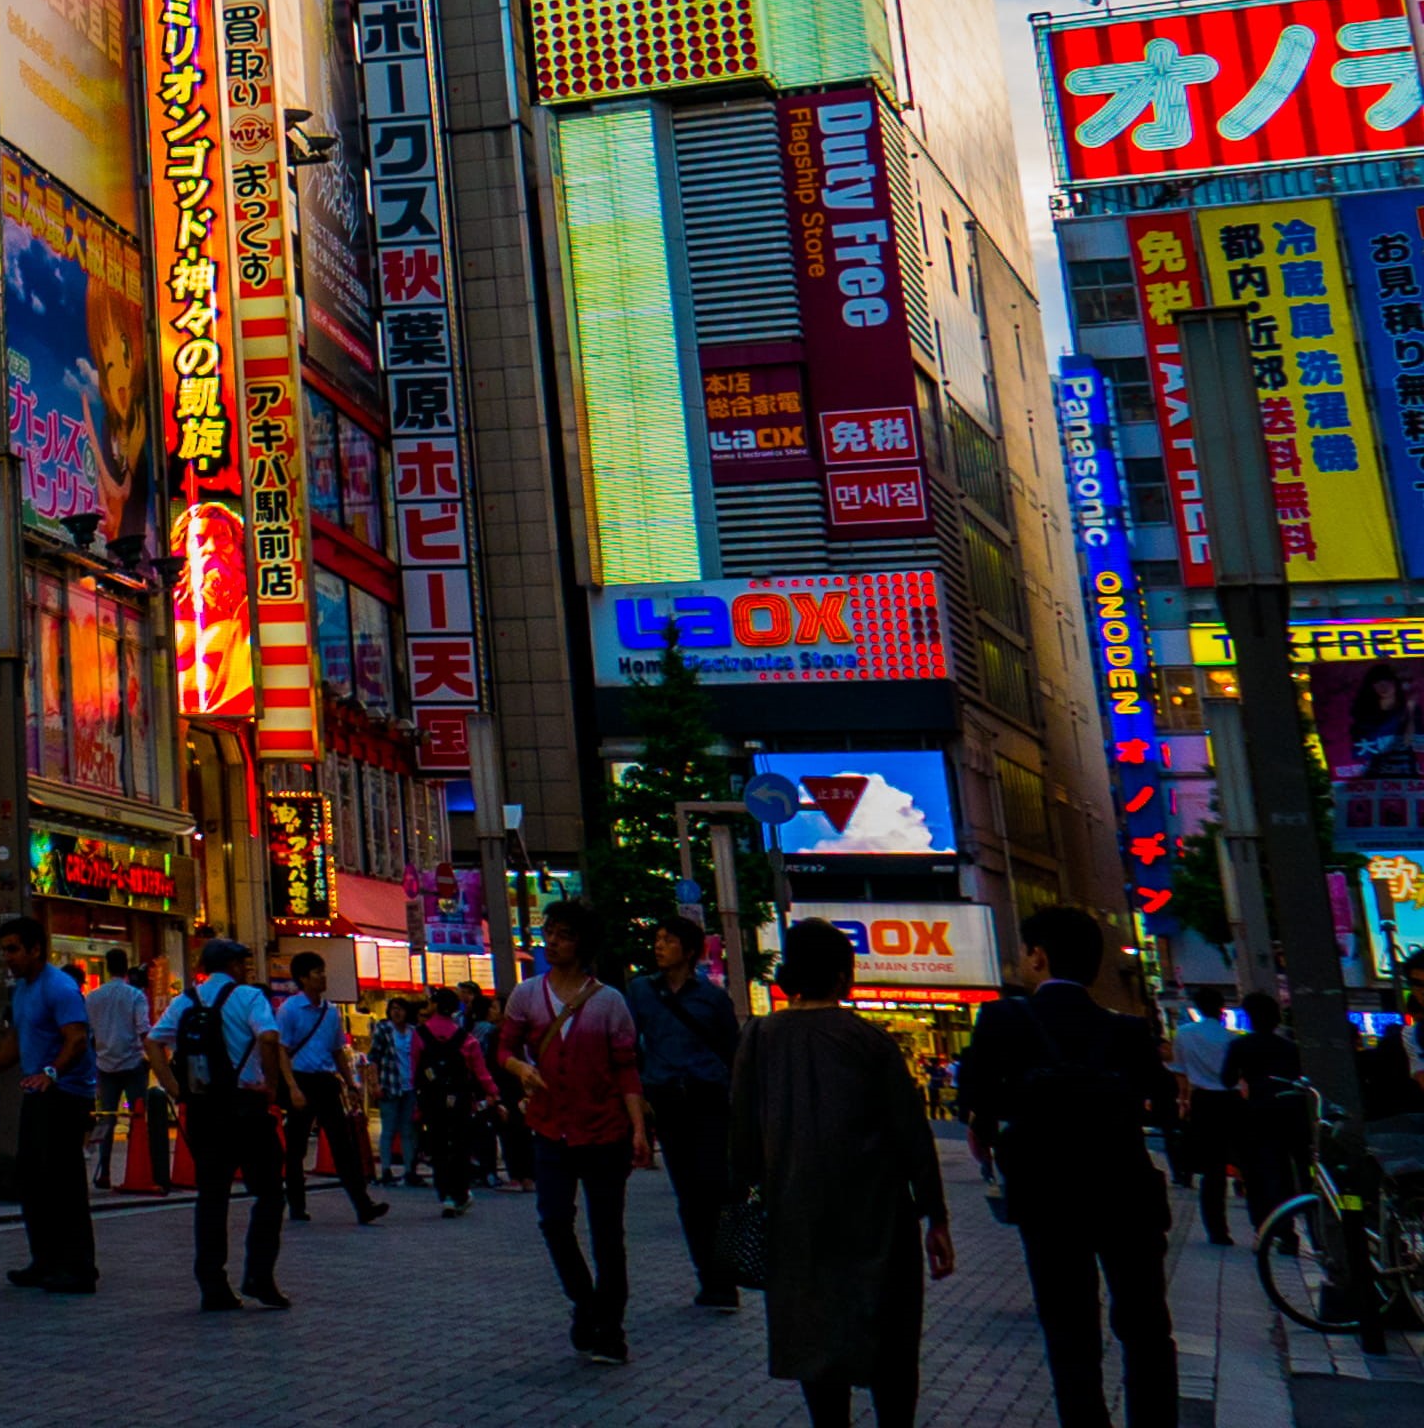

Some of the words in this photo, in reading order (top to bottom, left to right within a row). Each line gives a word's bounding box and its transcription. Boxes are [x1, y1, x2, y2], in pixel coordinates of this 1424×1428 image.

[222, 6, 263, 108] 買取り
[787, 105, 816, 206] Flagship
[816, 101, 875, 210] Duty
[231, 163, 273, 289] まっくす
[800, 211, 827, 279] Store
[831, 218, 890, 329] Free
[829, 420, 911, 454] 免税
[1068, 375, 1116, 548] Panasonic
[246, 382, 298, 601] アキバ駅前店
[835, 479, 921, 513] 면세점
[798, 650, 857, 673] Store
[1094, 570, 1141, 716] ONODEN
[816, 786, 856, 801] 止まれ
[875, 961, 908, 973] MAIN
[910, 962, 955, 974] STORE
